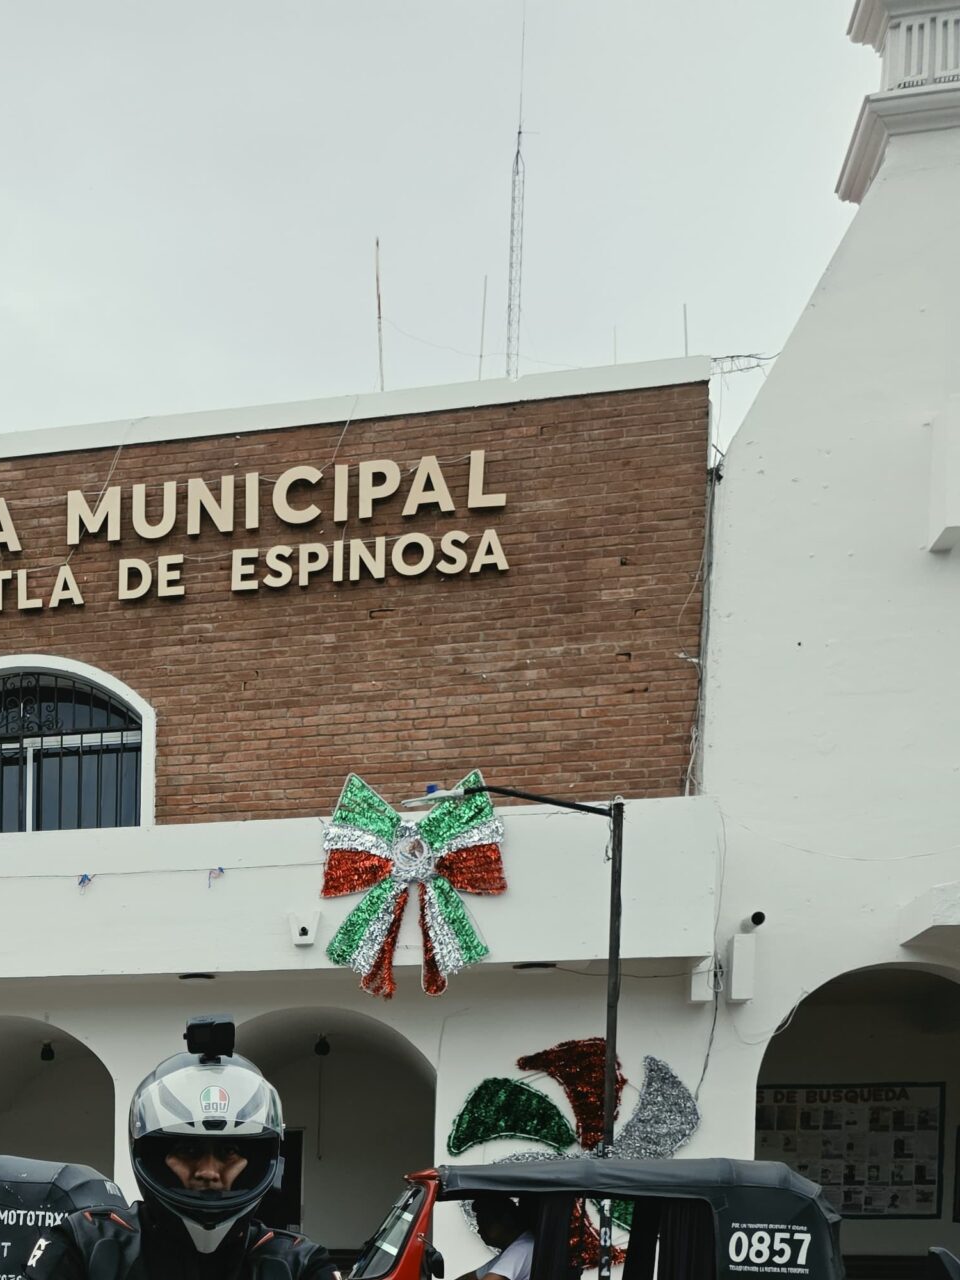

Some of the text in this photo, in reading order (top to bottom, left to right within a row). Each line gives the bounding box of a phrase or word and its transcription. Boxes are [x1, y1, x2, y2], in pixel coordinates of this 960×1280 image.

[66, 449, 507, 546] MUNICIPAL
[118, 553, 185, 600] DE
[231, 528, 509, 592] ESPINOSA
[773, 1090, 797, 1104] DE
[806, 1087, 910, 1105] BUSQUEDA
[728, 1230, 812, 1266] 0857
